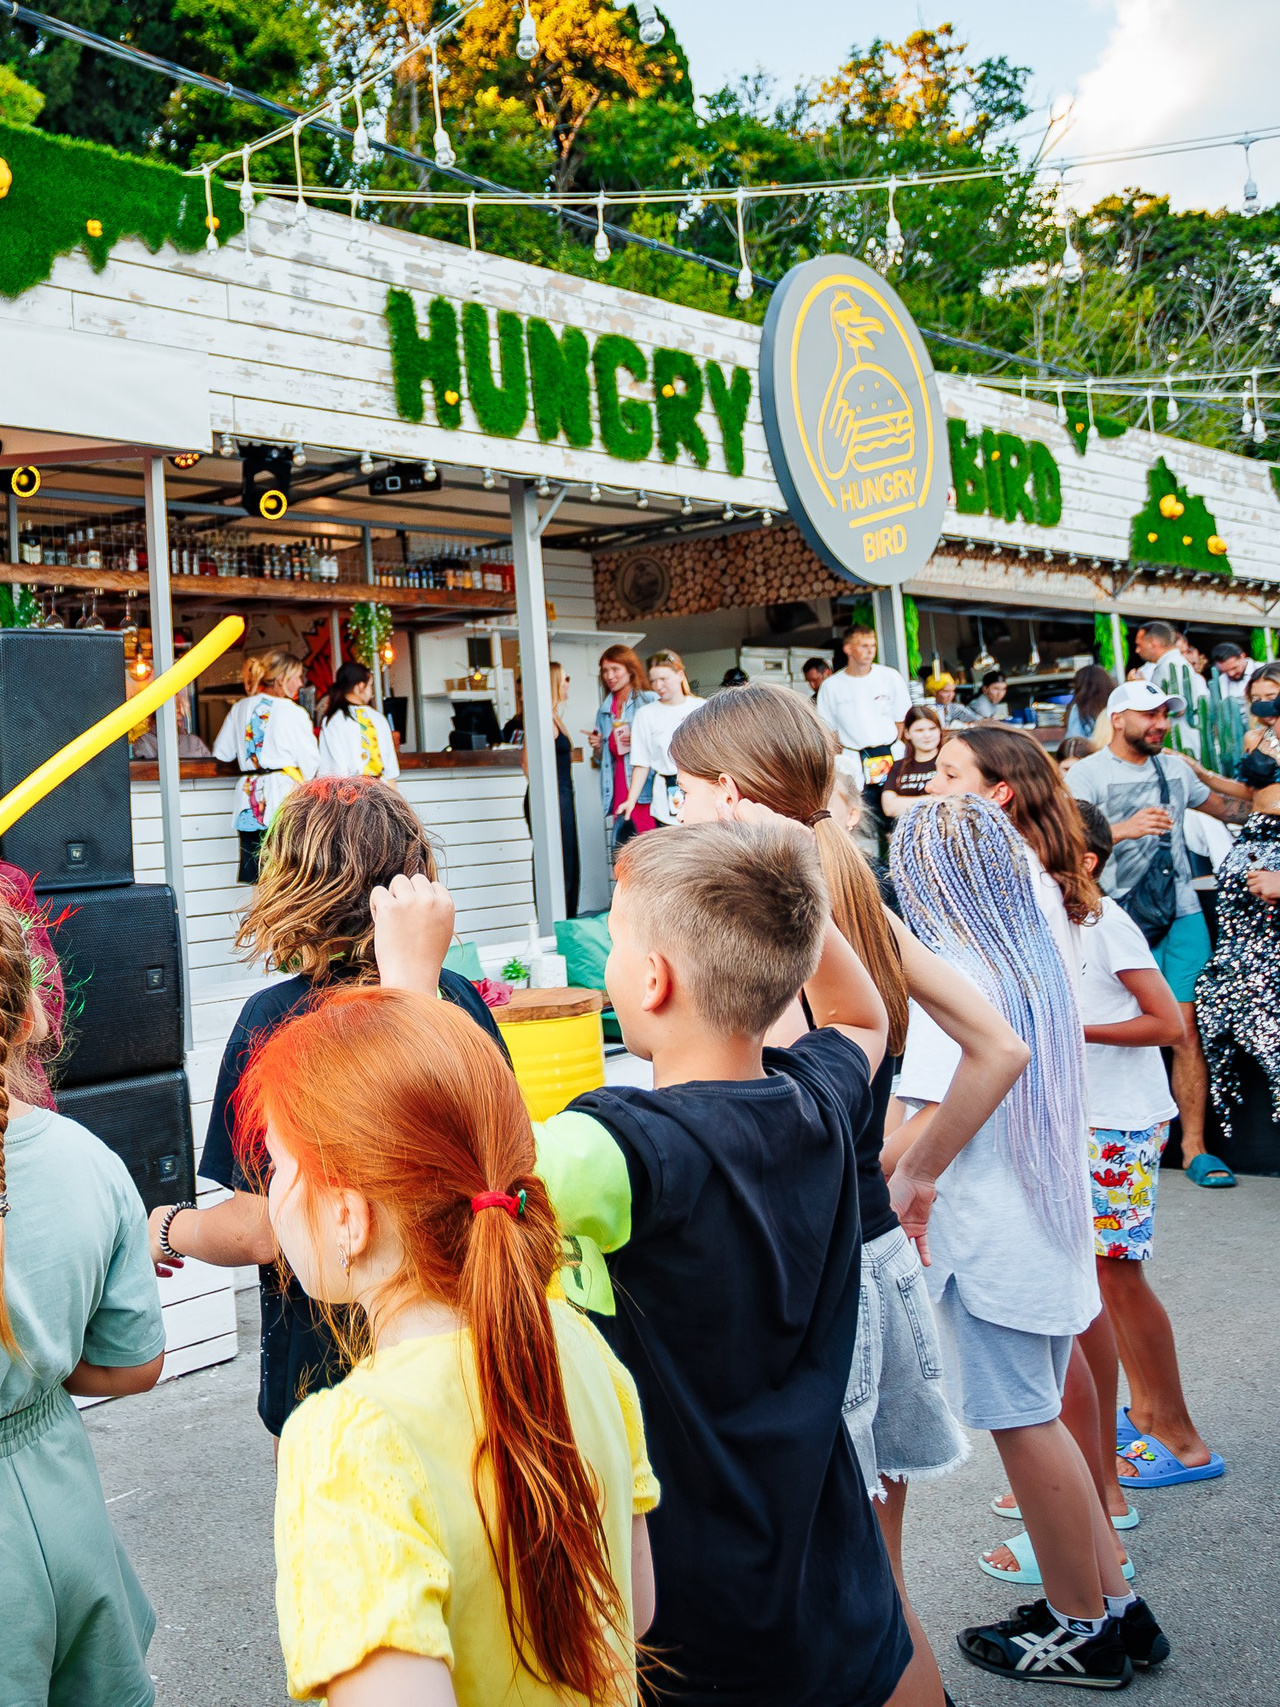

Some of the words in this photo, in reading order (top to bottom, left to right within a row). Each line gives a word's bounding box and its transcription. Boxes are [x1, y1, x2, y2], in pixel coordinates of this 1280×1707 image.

[385, 284, 751, 477] HUNGRY
[840, 466, 917, 513] HUNGRY
[947, 416, 1062, 528] BIRD
[863, 523, 907, 563] BIRD
